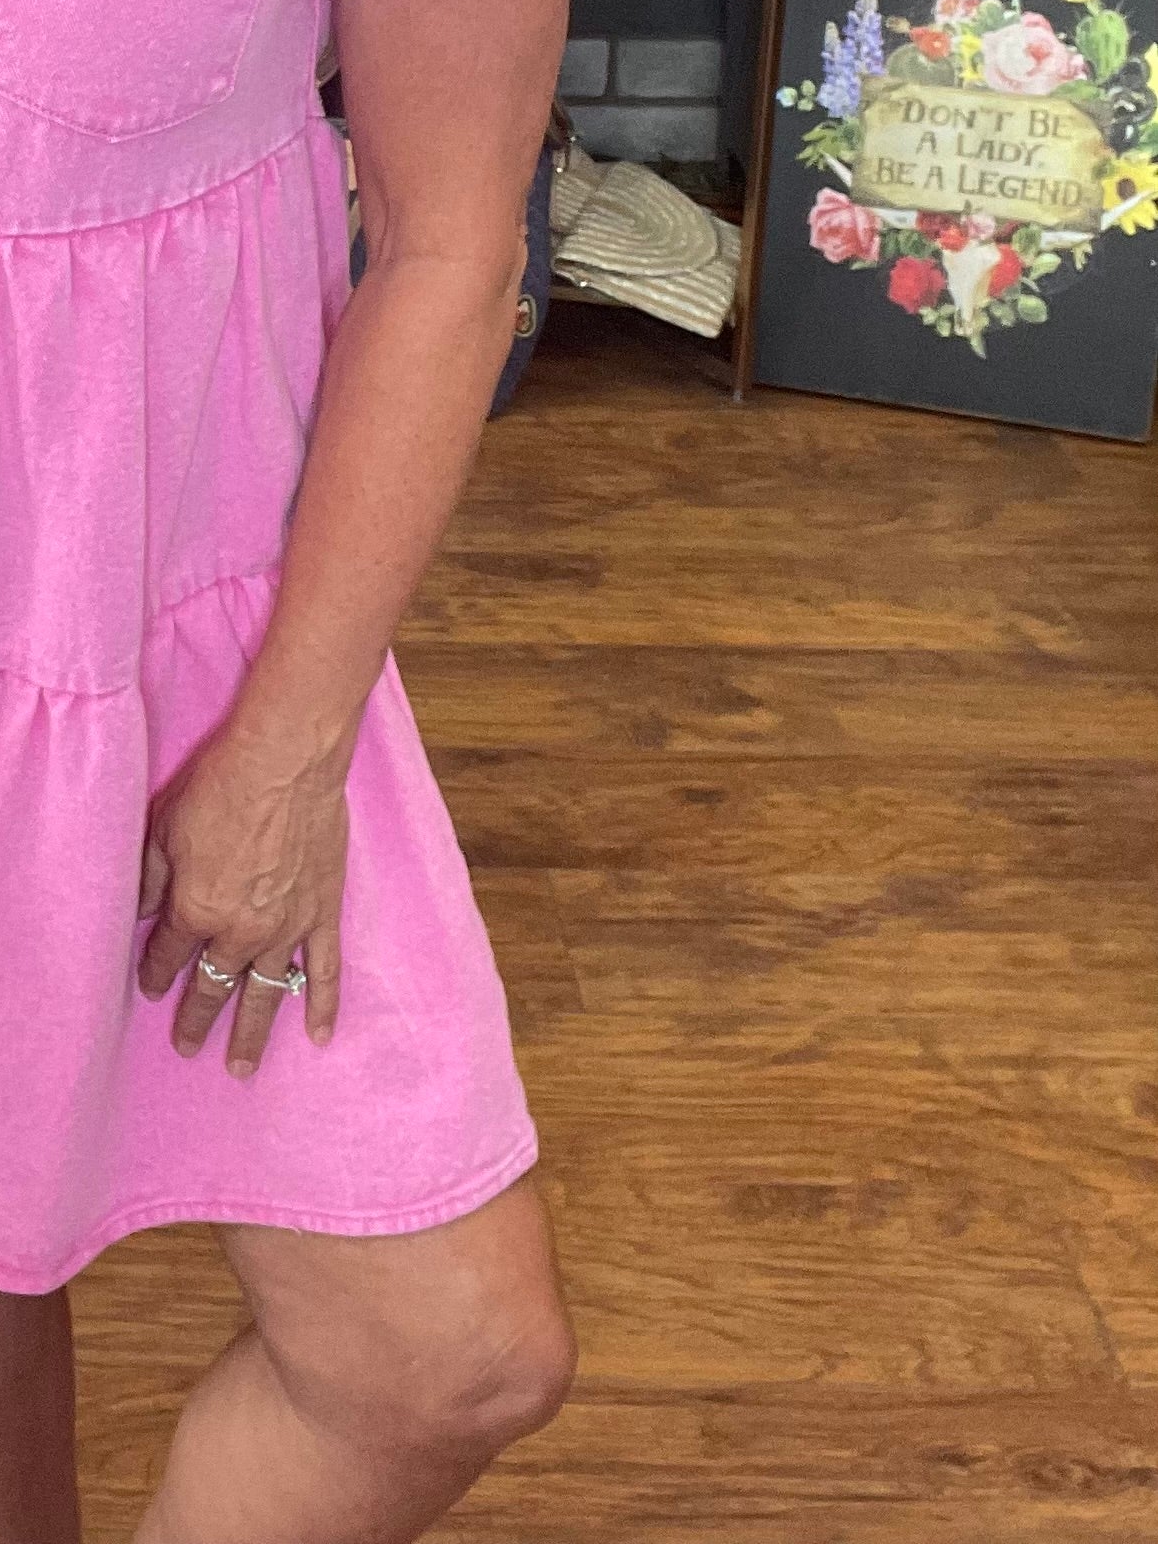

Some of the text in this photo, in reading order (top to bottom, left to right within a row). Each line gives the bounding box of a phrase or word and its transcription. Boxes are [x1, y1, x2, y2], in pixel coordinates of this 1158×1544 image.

[902, 99, 1072, 139] DON'T BE
[916, 131, 937, 155] A
[876, 157, 917, 186] BE
[923, 166, 944, 190] A
